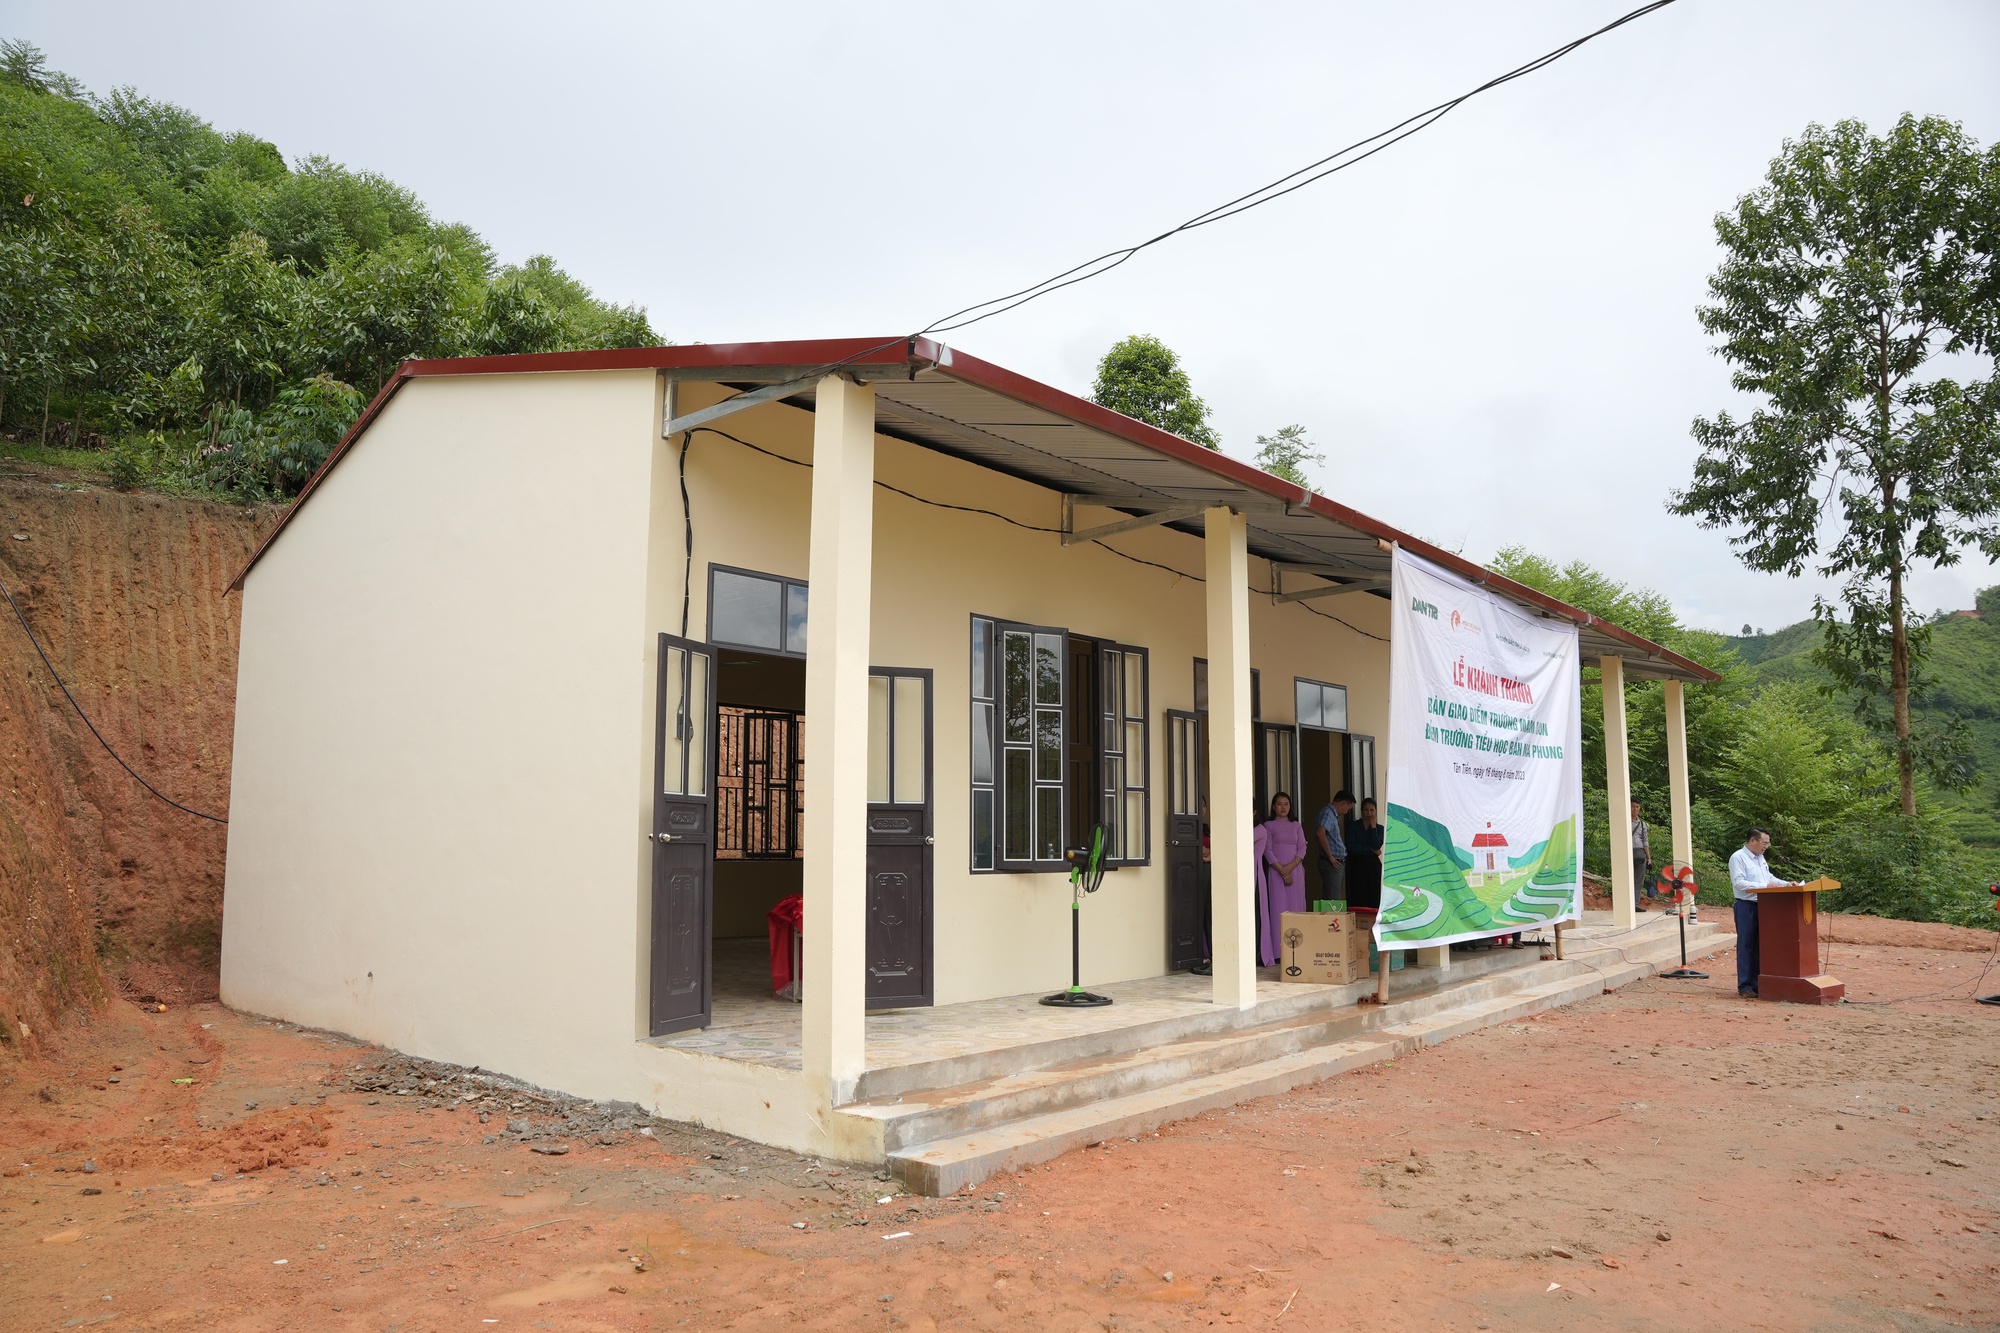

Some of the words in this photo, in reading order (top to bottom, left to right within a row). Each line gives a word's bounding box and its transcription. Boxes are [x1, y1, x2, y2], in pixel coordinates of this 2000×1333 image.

[1453, 655, 1465, 687] LỄ
[1467, 666, 1499, 697] KHÁNH
[1500, 675, 1534, 704] THÀNH
[1427, 694, 1446, 716] BÀN
[1448, 702, 1468, 721] GIAO
[1469, 702, 1488, 726] ĐIỂM
[1489, 711, 1519, 731] TRƯỜNG
[1440, 727, 1474, 749] TRƯỜNG
[1475, 730, 1493, 752] TIỂU
[1493, 738, 1509, 757] HỌC
[1532, 744, 1563, 759] PHUNG
[1472, 765, 1485, 779] ngày
